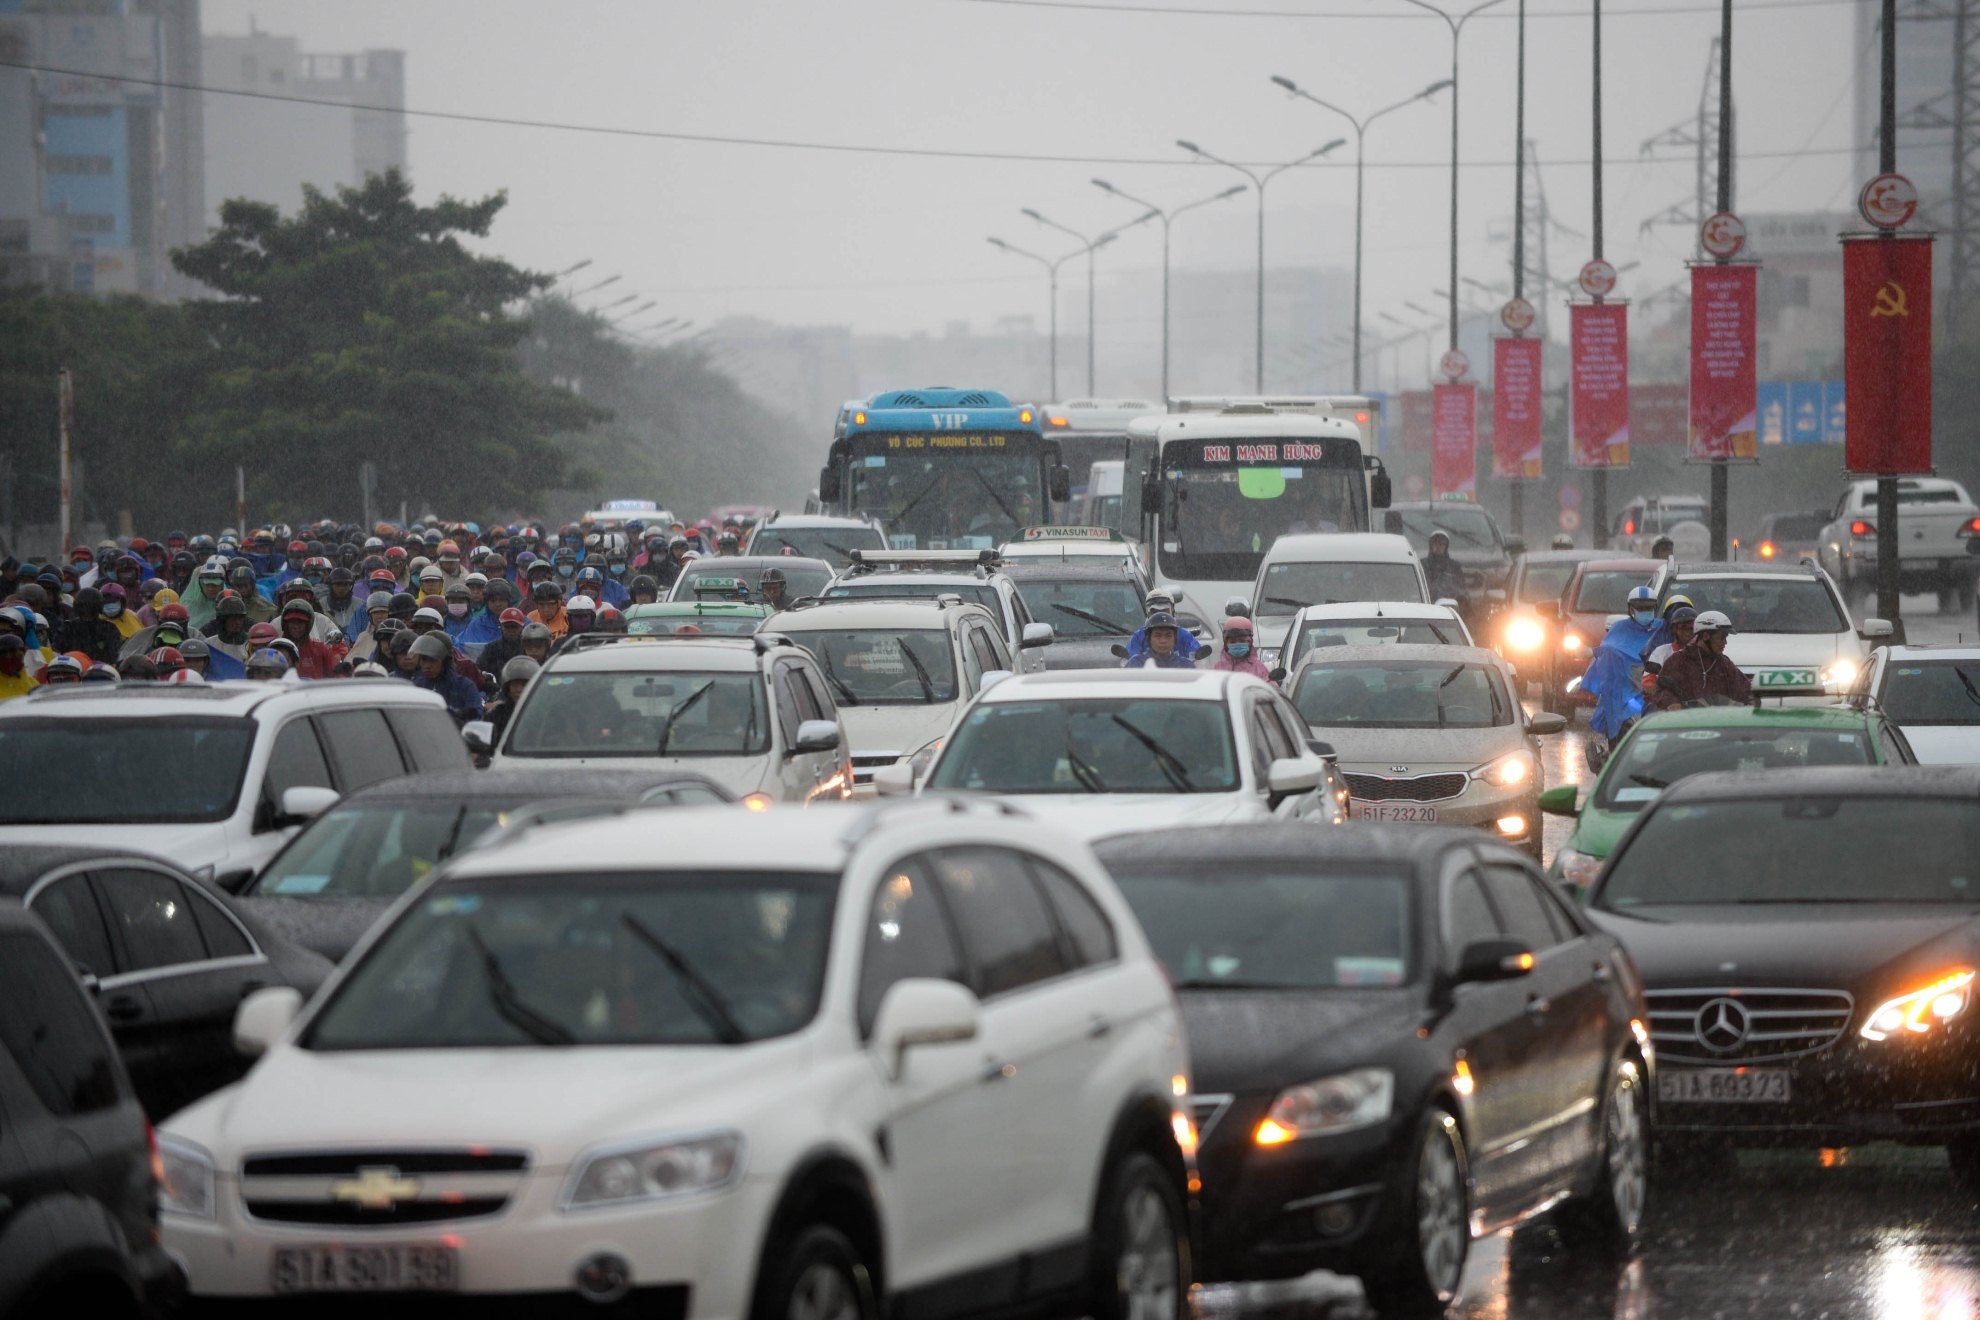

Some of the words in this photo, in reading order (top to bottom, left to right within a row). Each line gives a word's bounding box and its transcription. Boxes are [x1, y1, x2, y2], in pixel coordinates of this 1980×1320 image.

[931, 414, 968, 430] VIP
[989, 435, 1005, 447] LTD
[1204, 445, 1230, 461] KIM
[1237, 445, 1277, 464] MẠNH
[1363, 807, 1435, 822] 51F-232.20
